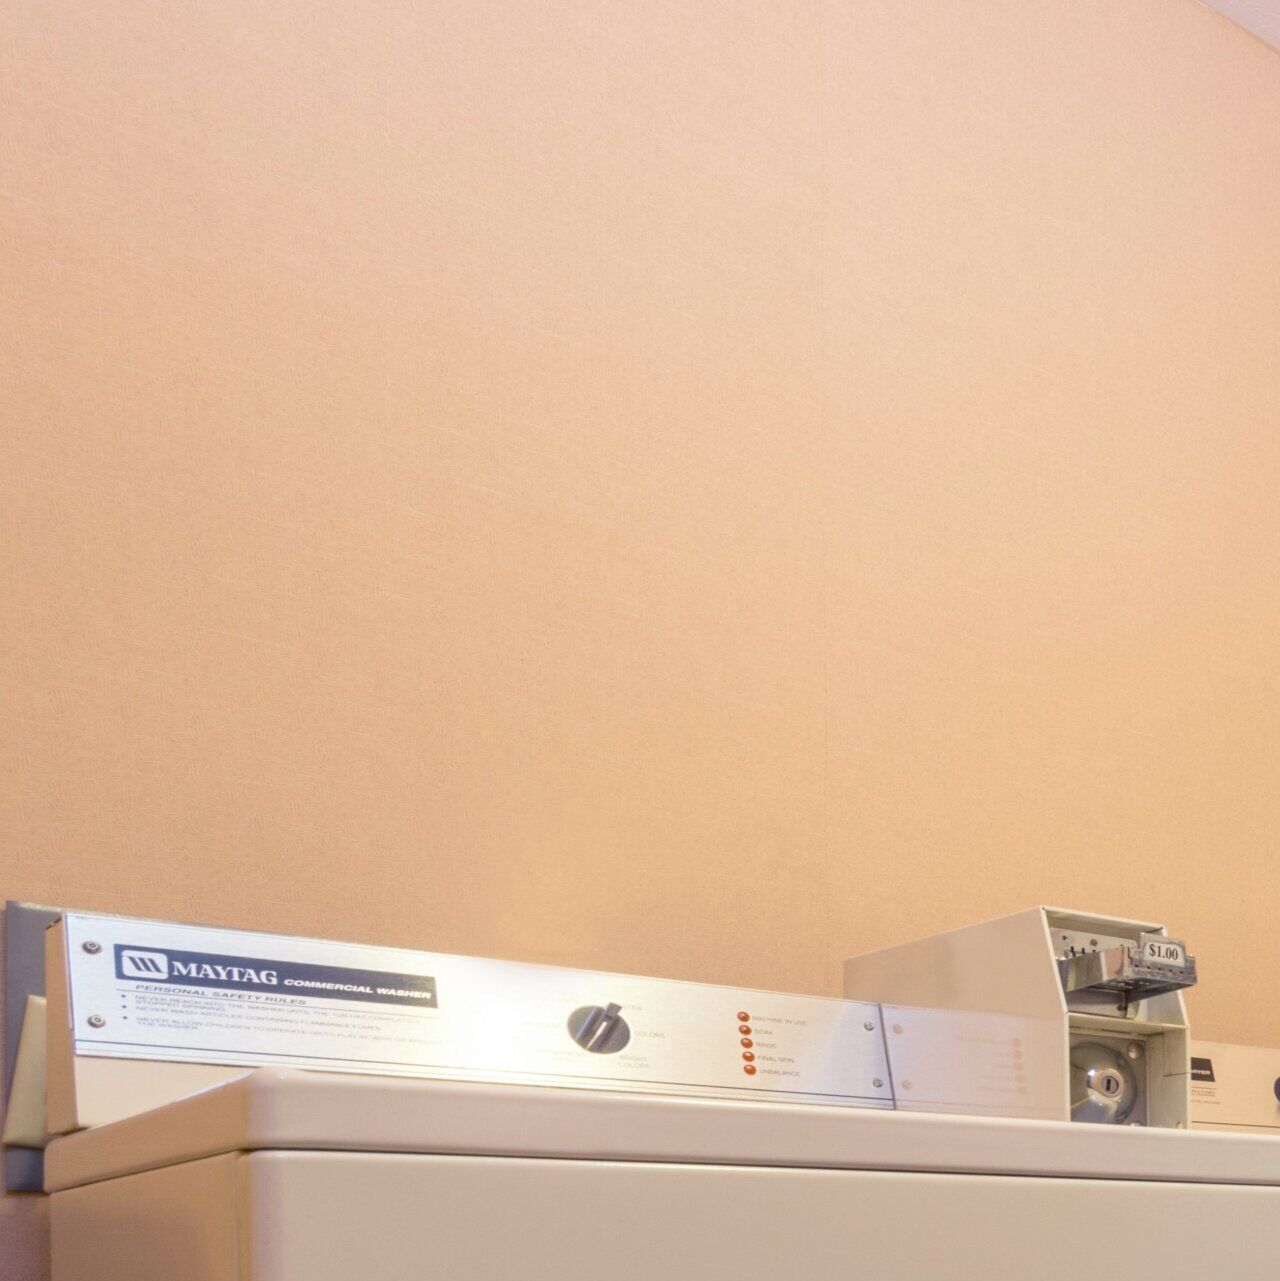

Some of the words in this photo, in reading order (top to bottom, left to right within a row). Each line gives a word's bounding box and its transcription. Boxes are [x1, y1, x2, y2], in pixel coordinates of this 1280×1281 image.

[1148, 943, 1179, 961] $1.00
[172, 961, 278, 985] MAYTAG
[284, 979, 374, 994] COMMERCIAL
[376, 987, 432, 999] WASHER
[135, 984, 208, 997] PERSONAL
[212, 988, 262, 1001] SAFETY
[265, 996, 307, 1005] RULES
